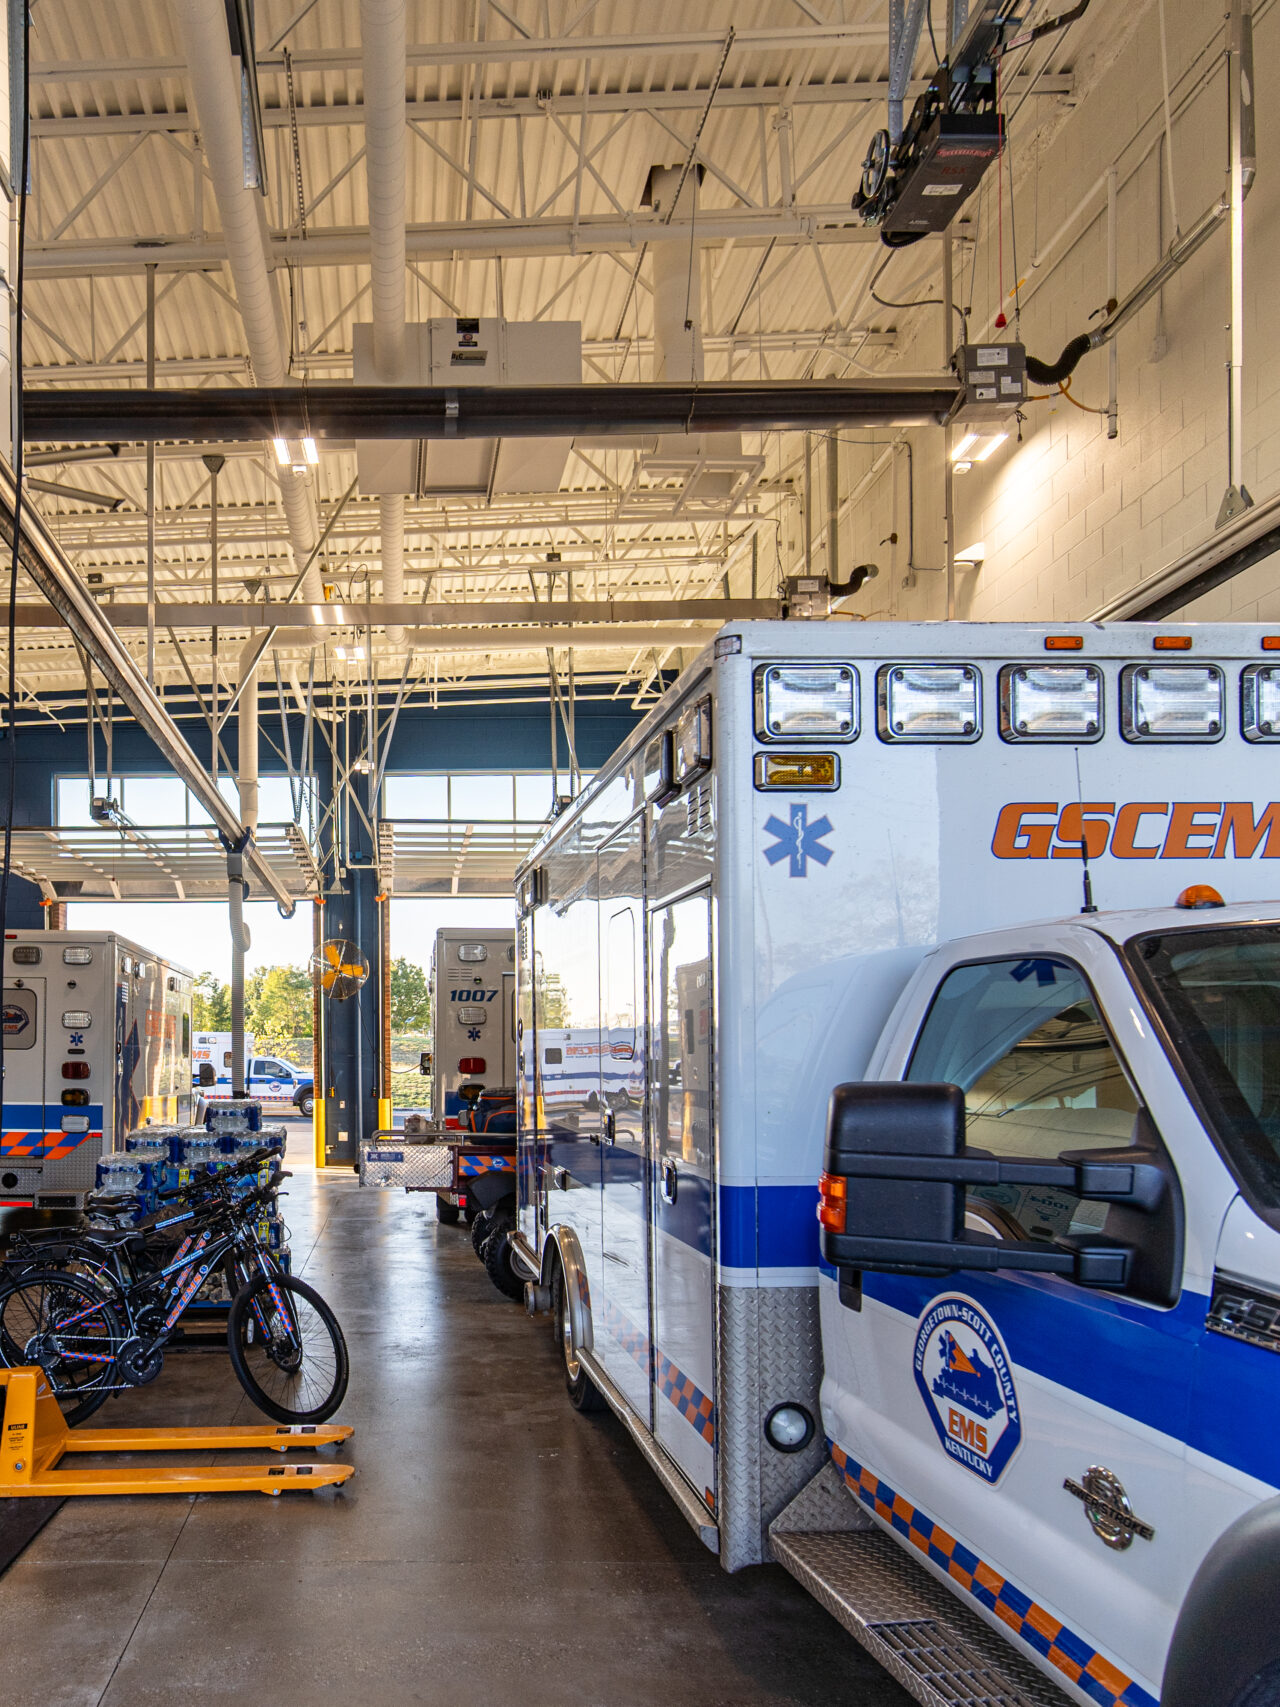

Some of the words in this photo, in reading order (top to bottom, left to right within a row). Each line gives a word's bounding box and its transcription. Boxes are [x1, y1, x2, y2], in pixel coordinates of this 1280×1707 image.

[450, 989, 498, 1002] 1007
[166, 1272, 202, 1329] GSCEMS
[914, 1304, 992, 1371] GEORGETOWN-SCOTT
[990, 1343, 1018, 1423] COUNTY
[948, 1406, 988, 1454] EMS
[944, 1437, 993, 1477] KENTUCKY
[1063, 1480, 1099, 1507] POWER
[1100, 1503, 1153, 1540] STROKE
